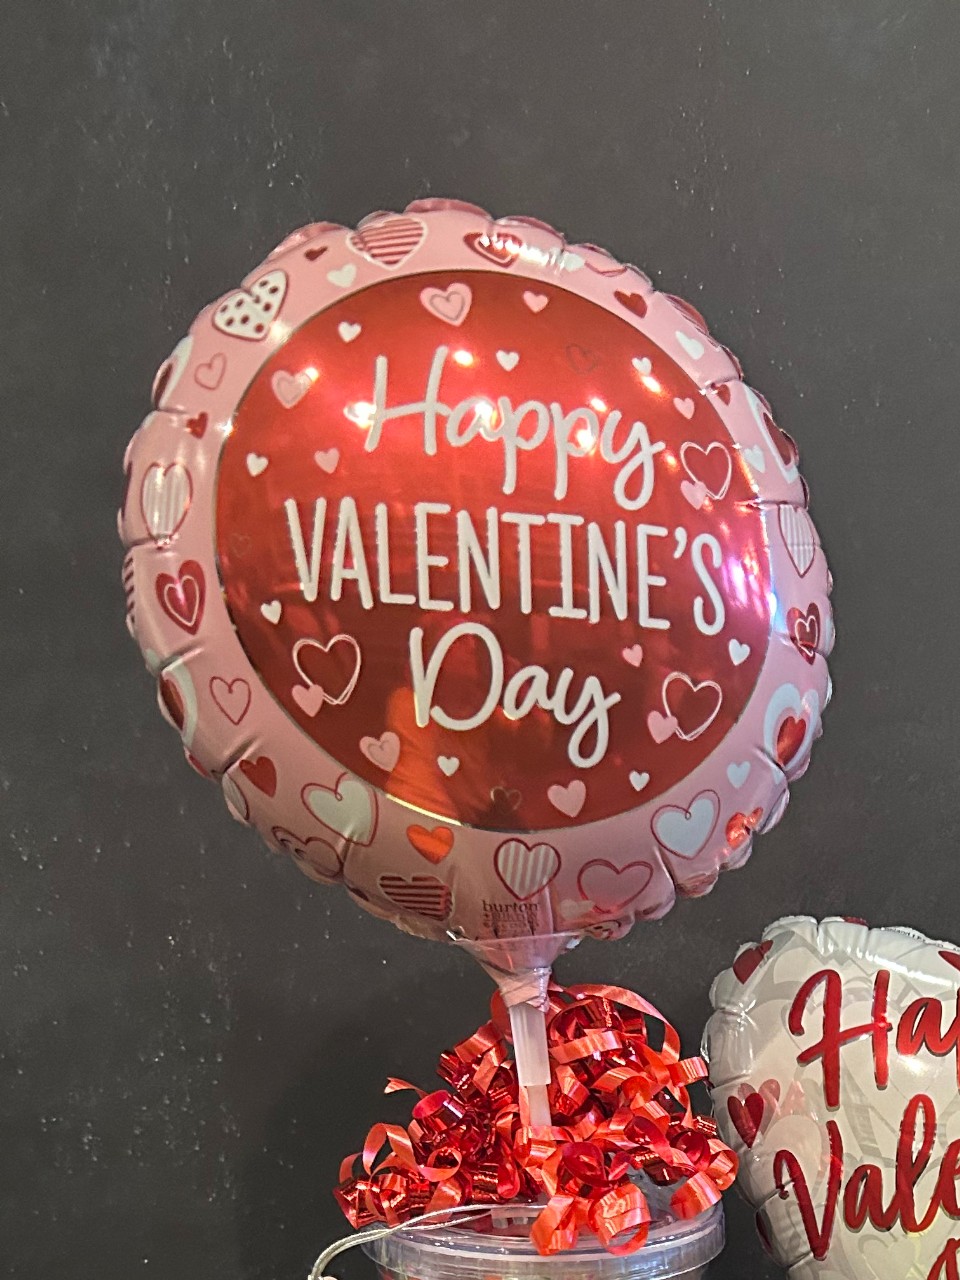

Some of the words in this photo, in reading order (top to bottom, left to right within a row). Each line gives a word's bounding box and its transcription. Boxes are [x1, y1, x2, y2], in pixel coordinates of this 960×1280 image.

[350, 344, 666, 511] Happy
[285, 496, 727, 636] VALENTINE'S
[409, 623, 621, 769] Day
